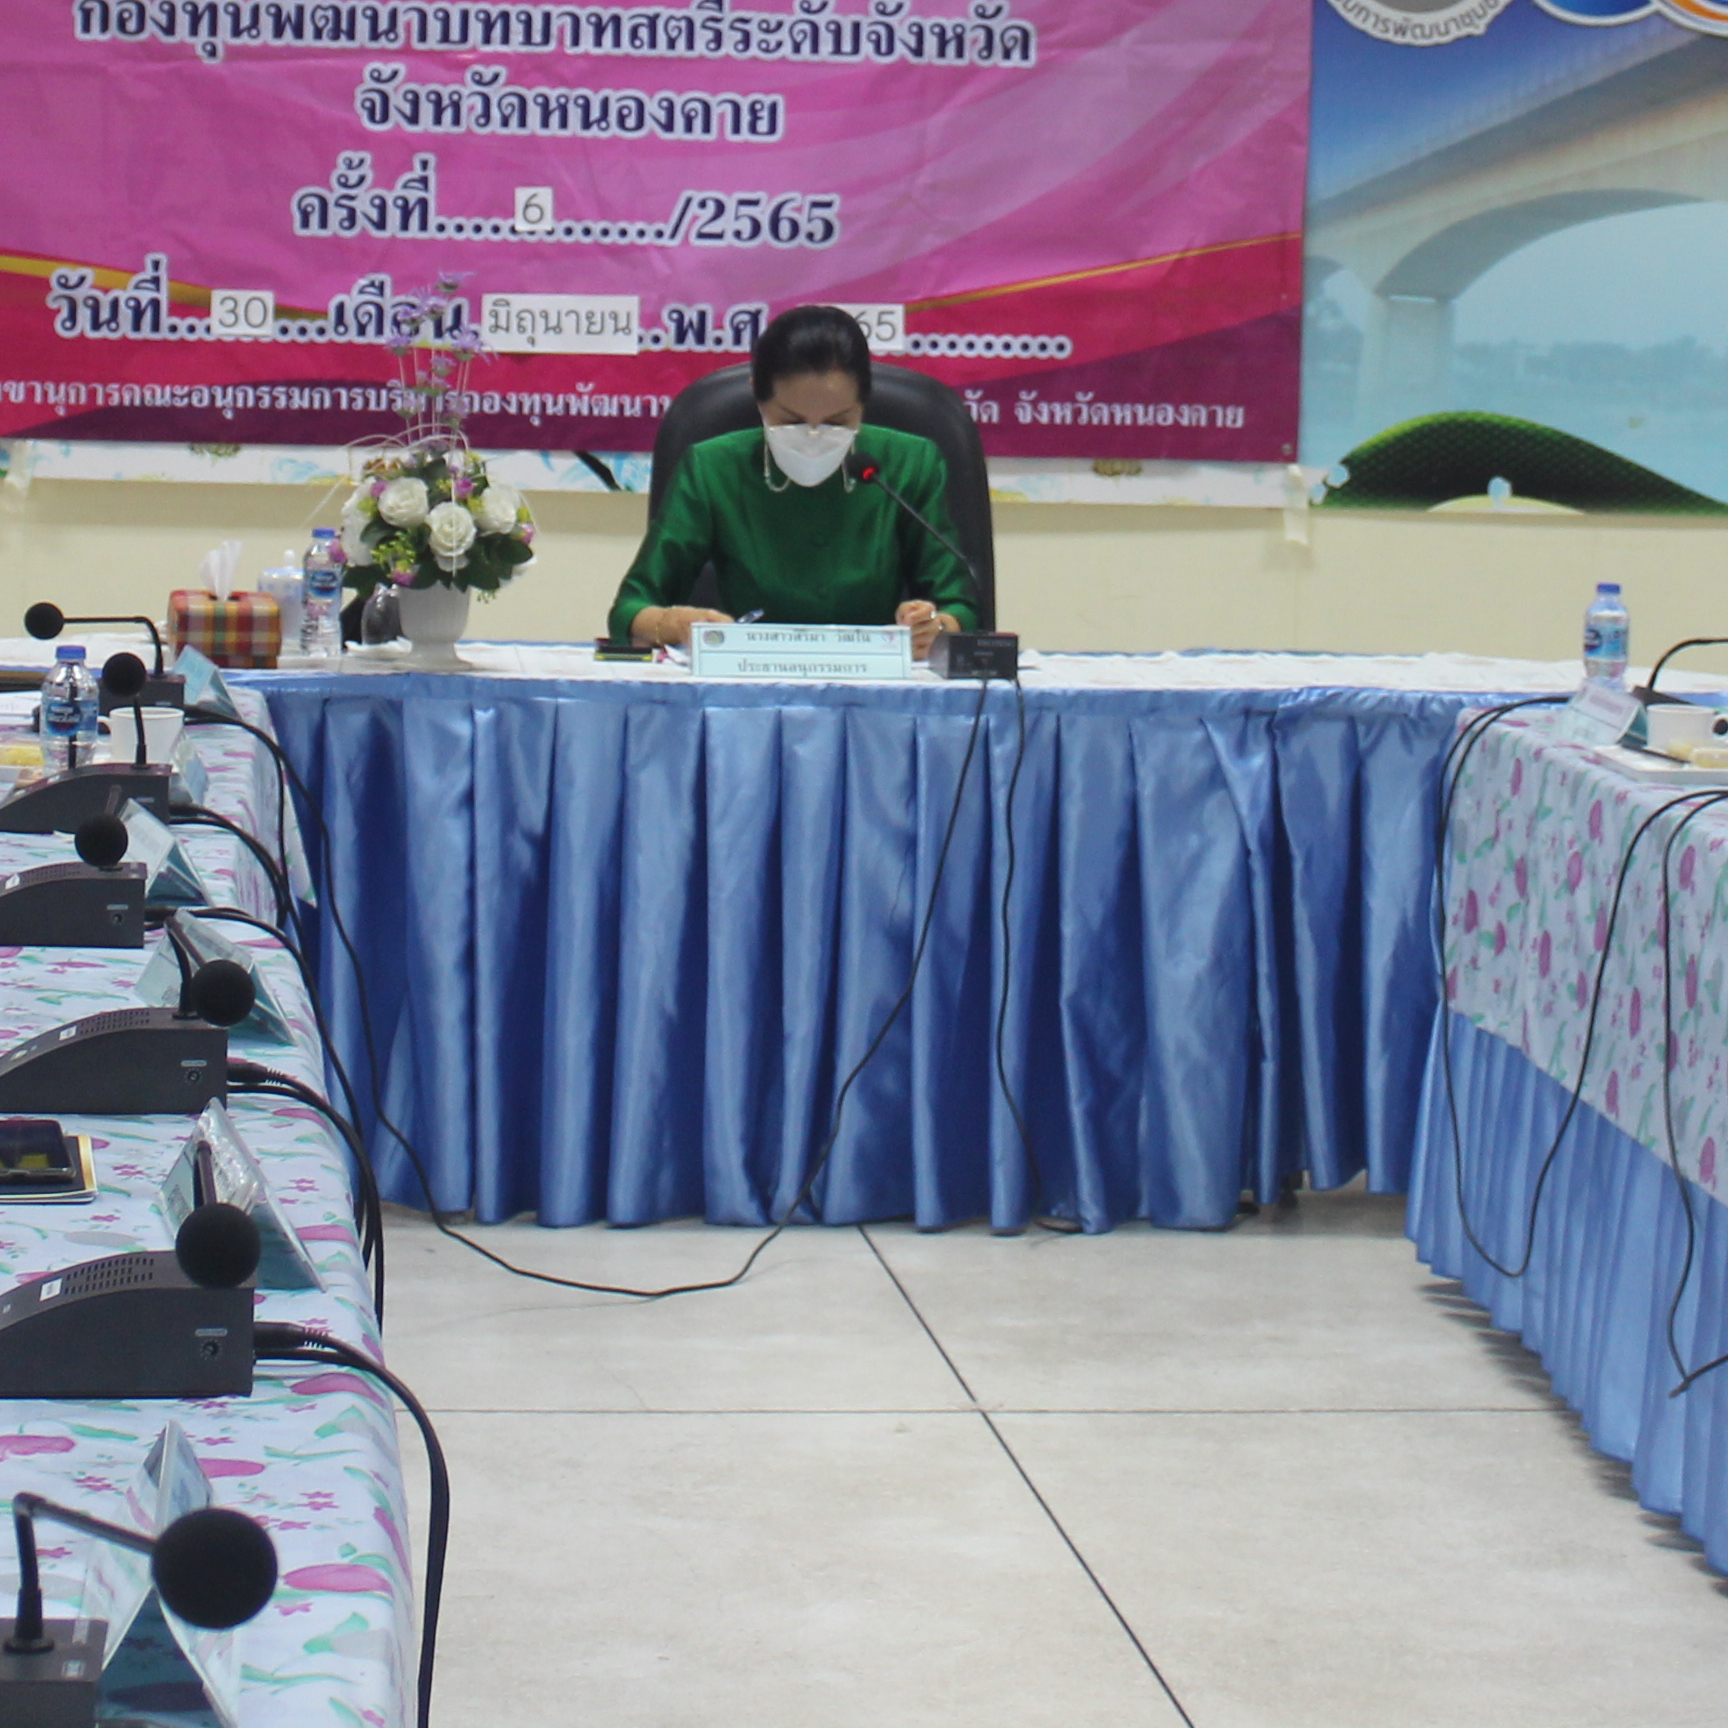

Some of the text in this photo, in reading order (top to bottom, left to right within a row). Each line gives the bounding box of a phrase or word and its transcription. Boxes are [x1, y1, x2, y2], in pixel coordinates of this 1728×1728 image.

[360, 68, 779, 138] จังหวัดหนองคาย
[1013, 389, 1246, 429] จังหวัดหนองคาย
